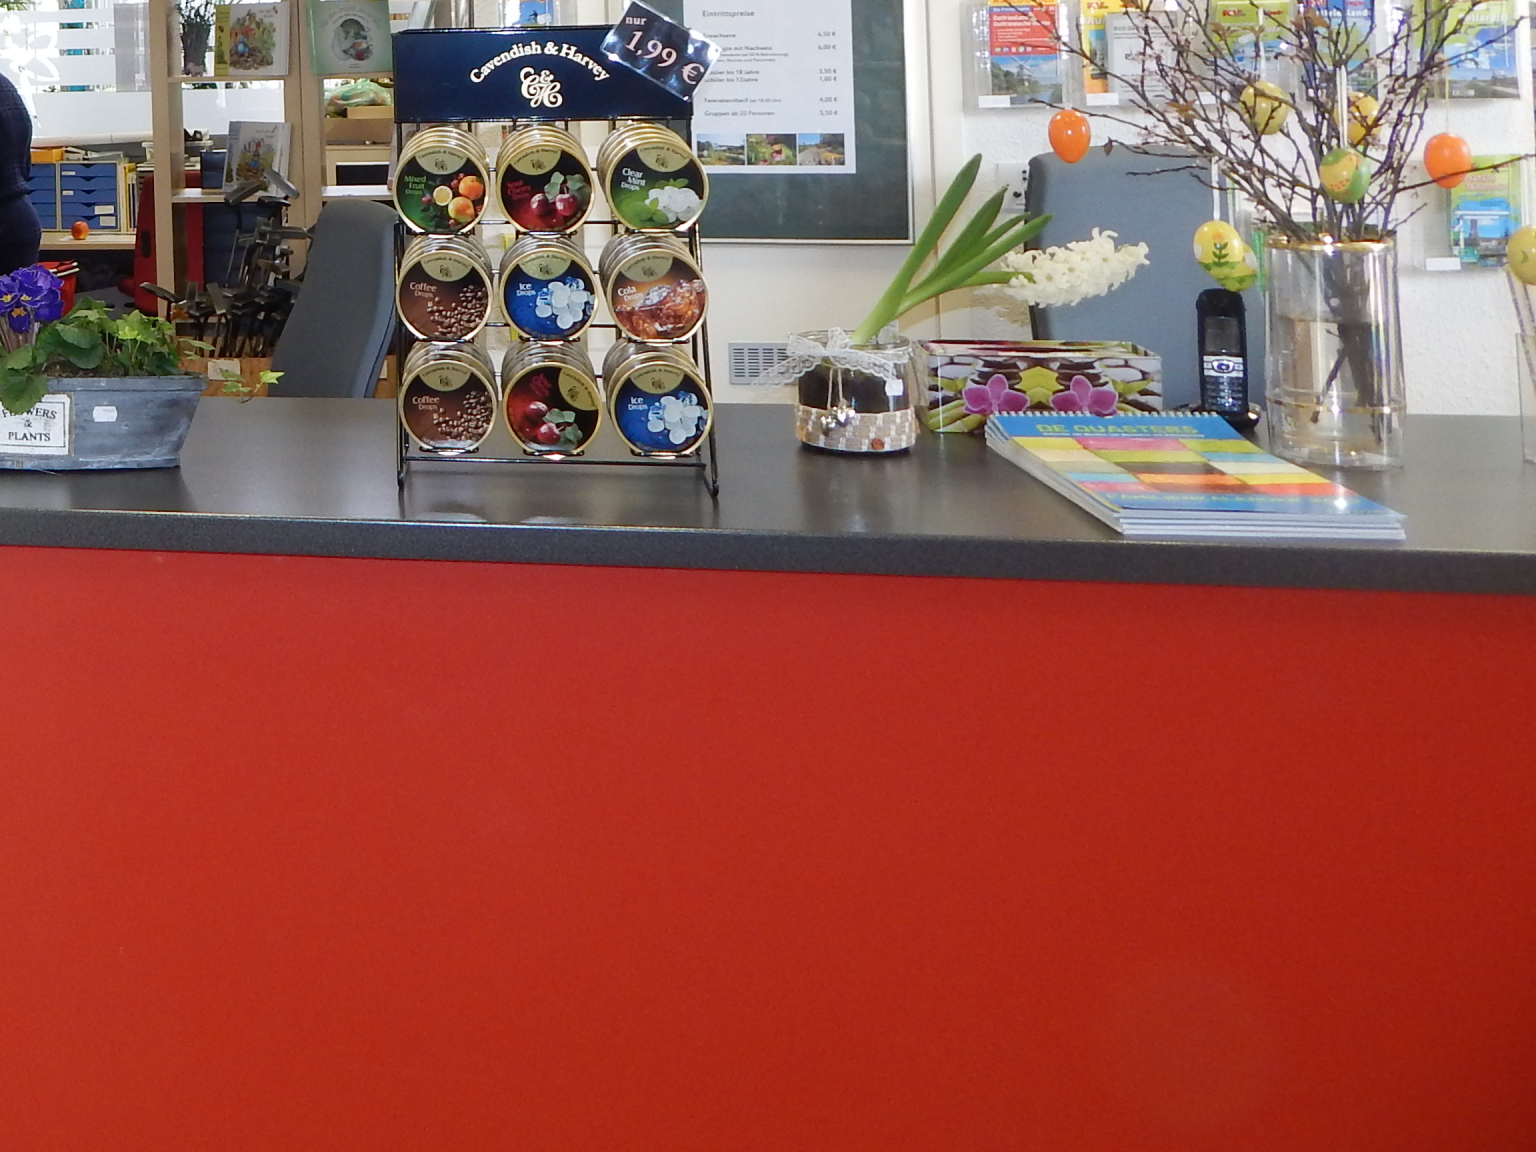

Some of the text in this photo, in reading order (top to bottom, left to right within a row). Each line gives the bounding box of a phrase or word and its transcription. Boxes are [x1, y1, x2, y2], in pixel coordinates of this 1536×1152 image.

[702, 10, 754, 18] Eintrittspreise
[625, 16, 646, 26] nur
[470, 40, 610, 83] Cavendish & Harvey
[625, 31, 704, 84] 1,99 €
[622, 168, 643, 178] Clear
[621, 182, 639, 190] Drops
[627, 176, 646, 186] Mint
[410, 282, 437, 292] Coffee
[618, 286, 636, 296] Cola
[412, 396, 439, 404] Coffee
[1, 407, 58, 419] FWERS
[1036, 424, 1069, 432] DE
[8, 432, 51, 442] PLANTS
